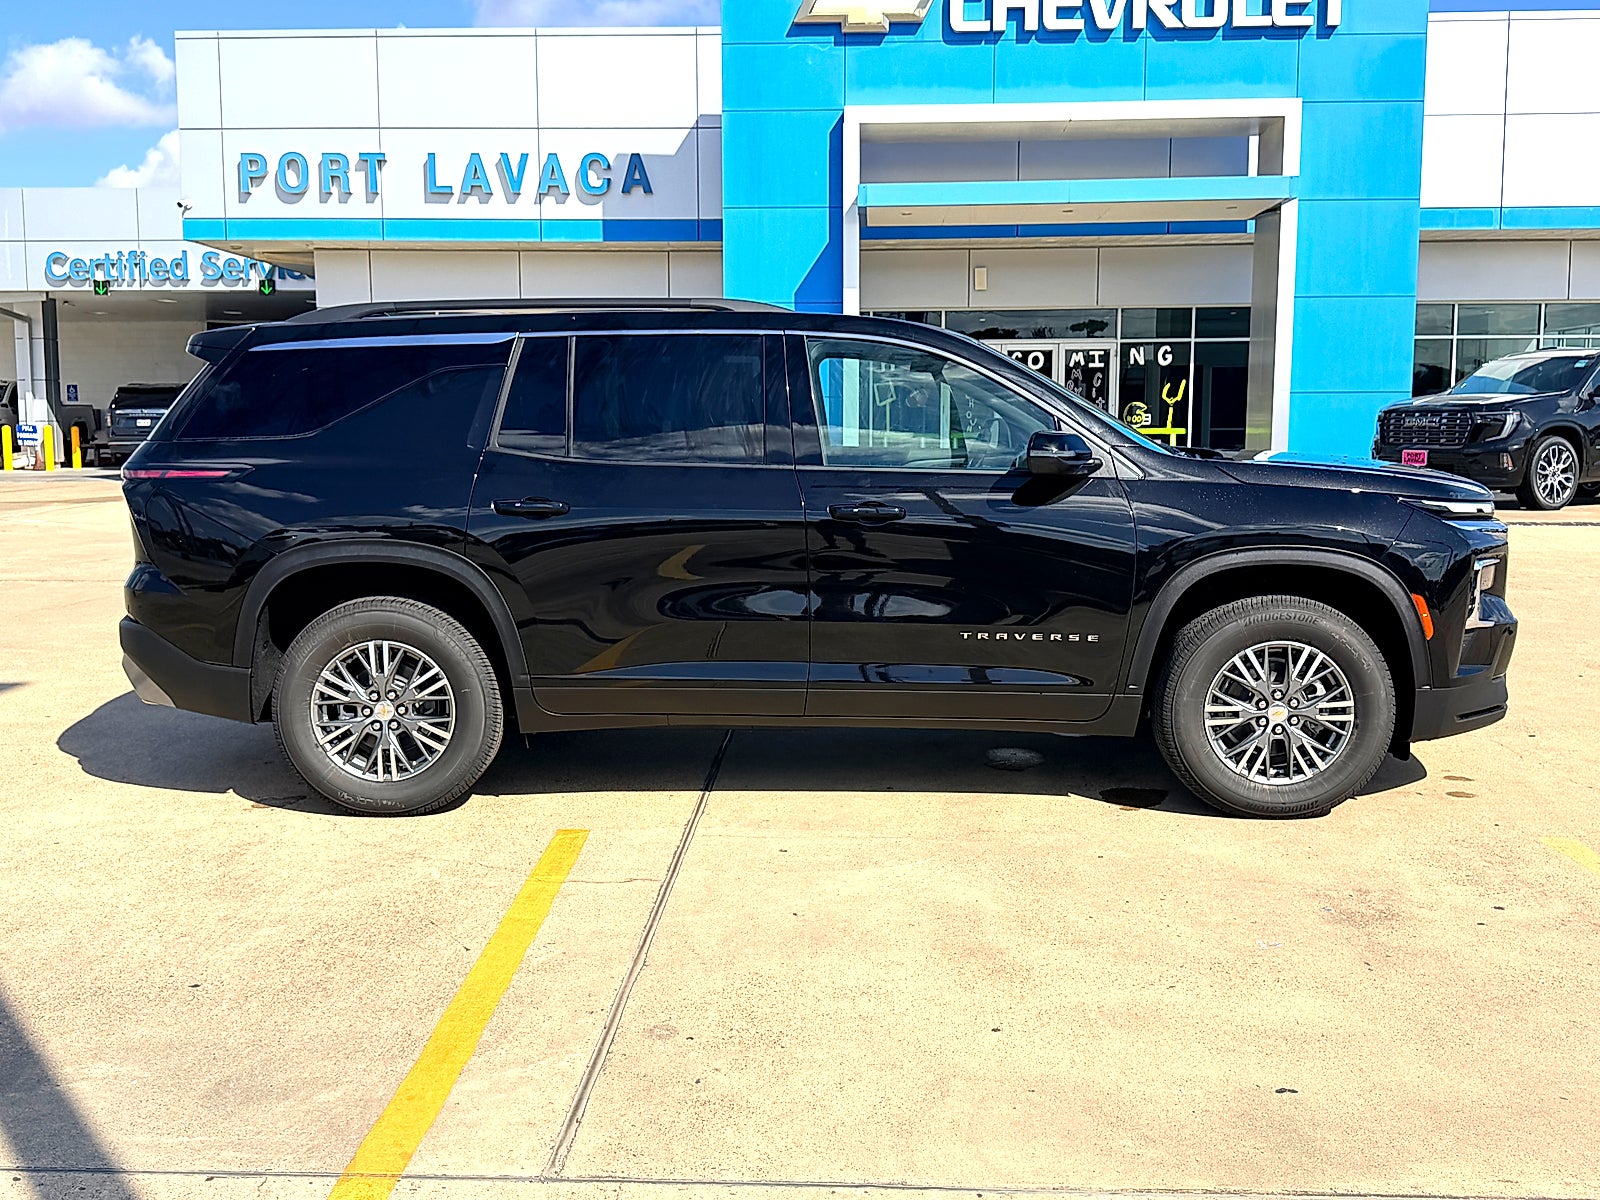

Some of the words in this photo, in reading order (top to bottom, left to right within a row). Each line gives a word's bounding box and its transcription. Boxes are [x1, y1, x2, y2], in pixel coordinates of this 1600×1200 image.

[948, 0, 1342, 33] CHEVROLET
[239, 151, 387, 197] PORT
[426, 151, 653, 197] LAVACA
[46, 250, 189, 281] Certified
[959, 632, 1100, 642] TRAVERSE
